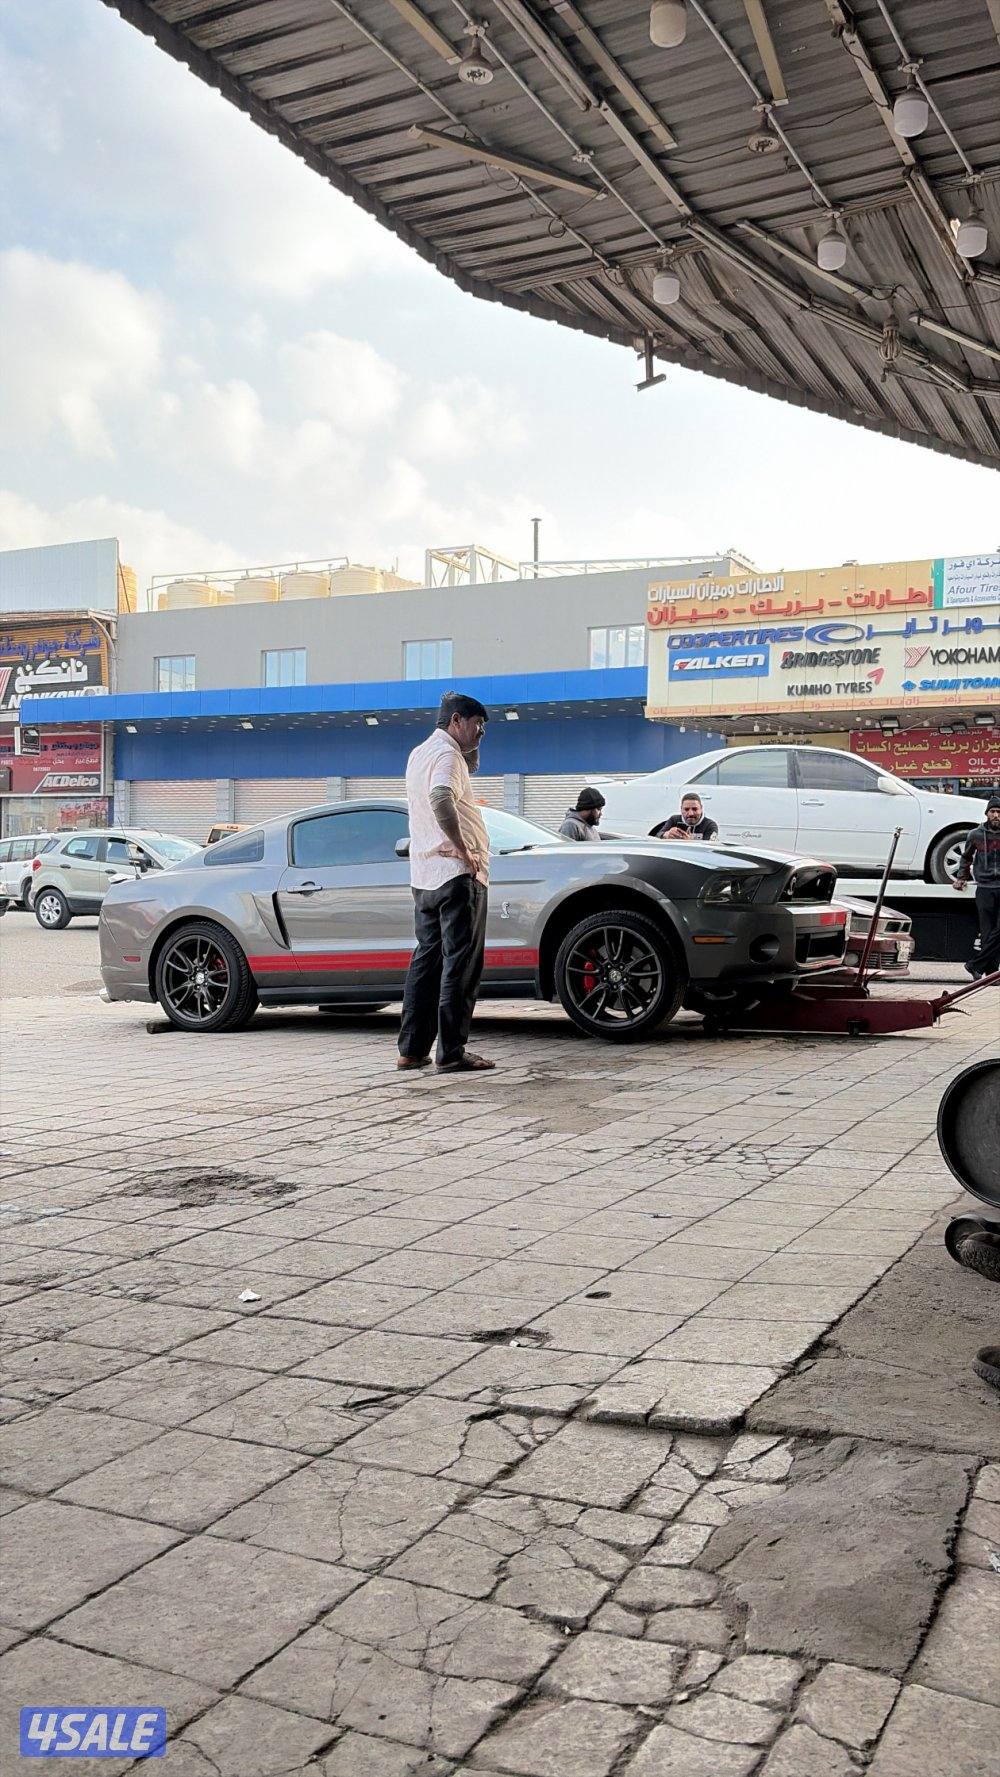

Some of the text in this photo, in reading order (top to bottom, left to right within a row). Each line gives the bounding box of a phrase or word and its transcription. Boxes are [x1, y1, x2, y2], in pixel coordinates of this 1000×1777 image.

[647, 583, 696, 604] السيارات
[696, 582, 735, 601] وميزان
[647, 604, 729, 626] ميزان
[749, 598, 824, 616] بريك
[672, 653, 766, 671] FALKEN
[780, 647, 881, 669] BRIDGESTONE
[787, 681, 873, 696] KUMHO TYRES
[918, 677, 1000, 691] SUMITOM
[893, 739, 930, 756] تصليح
[889, 760, 918, 773] غيار
[921, 759, 952, 774] قطع
[968, 757, 988, 766] OIL
[42, 775, 99, 788] ACDelco
